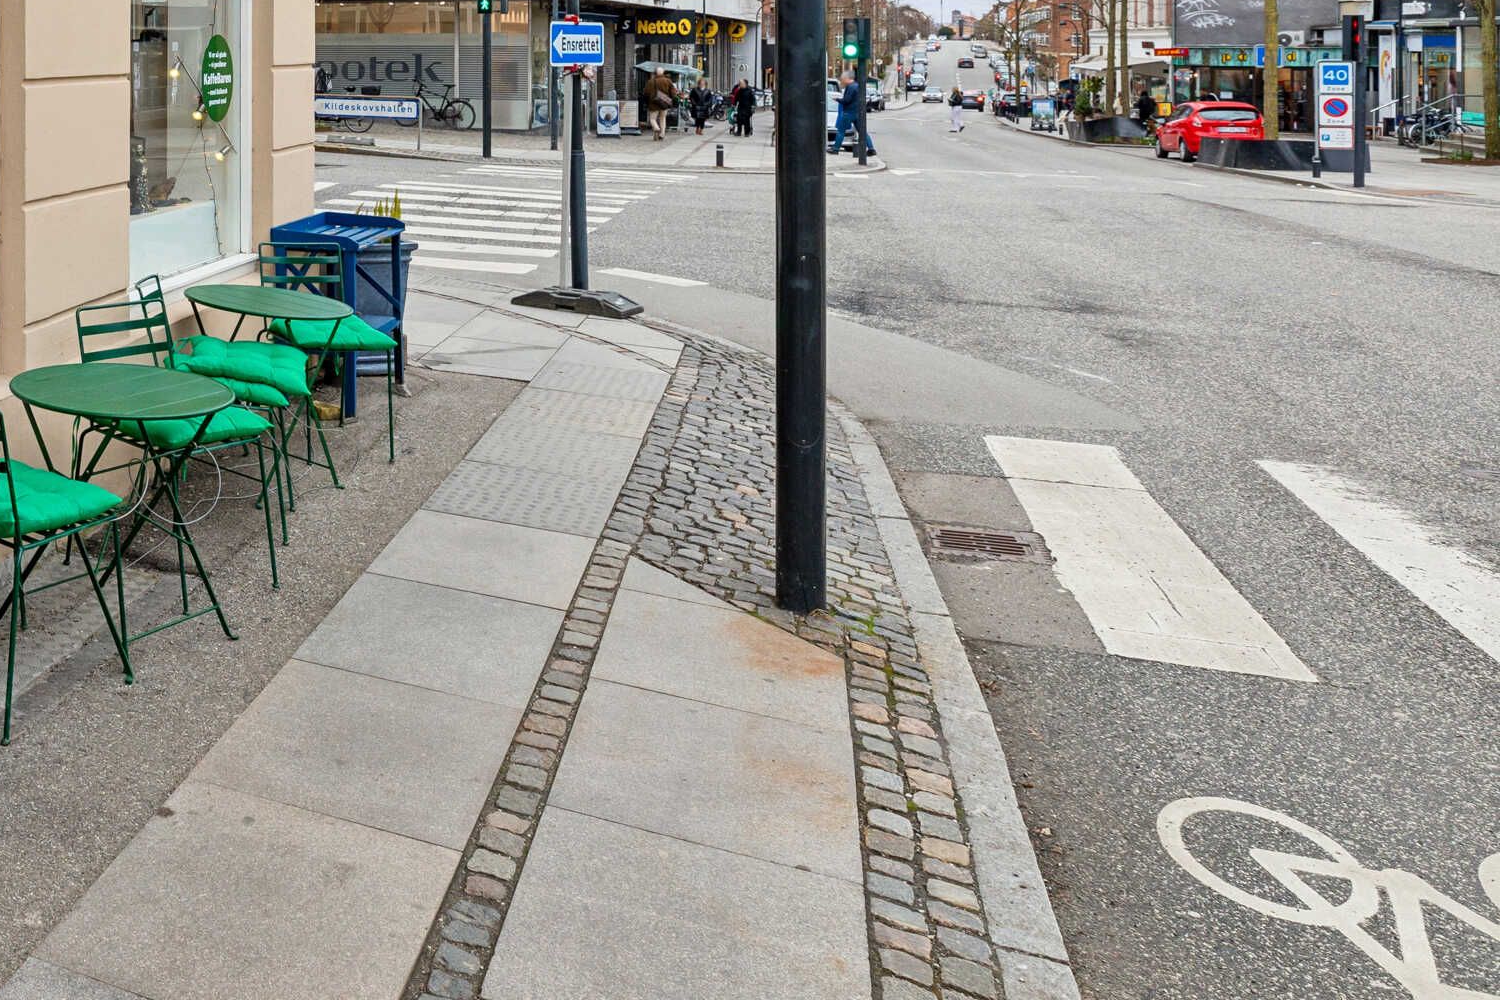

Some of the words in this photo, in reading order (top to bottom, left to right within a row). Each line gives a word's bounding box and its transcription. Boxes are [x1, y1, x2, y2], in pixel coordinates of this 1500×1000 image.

[637, 19, 677, 36] Netto
[561, 36, 600, 52] Ensrettet
[1323, 69, 1348, 81] 40
[324, 102, 413, 114] Kildeskovshallen
